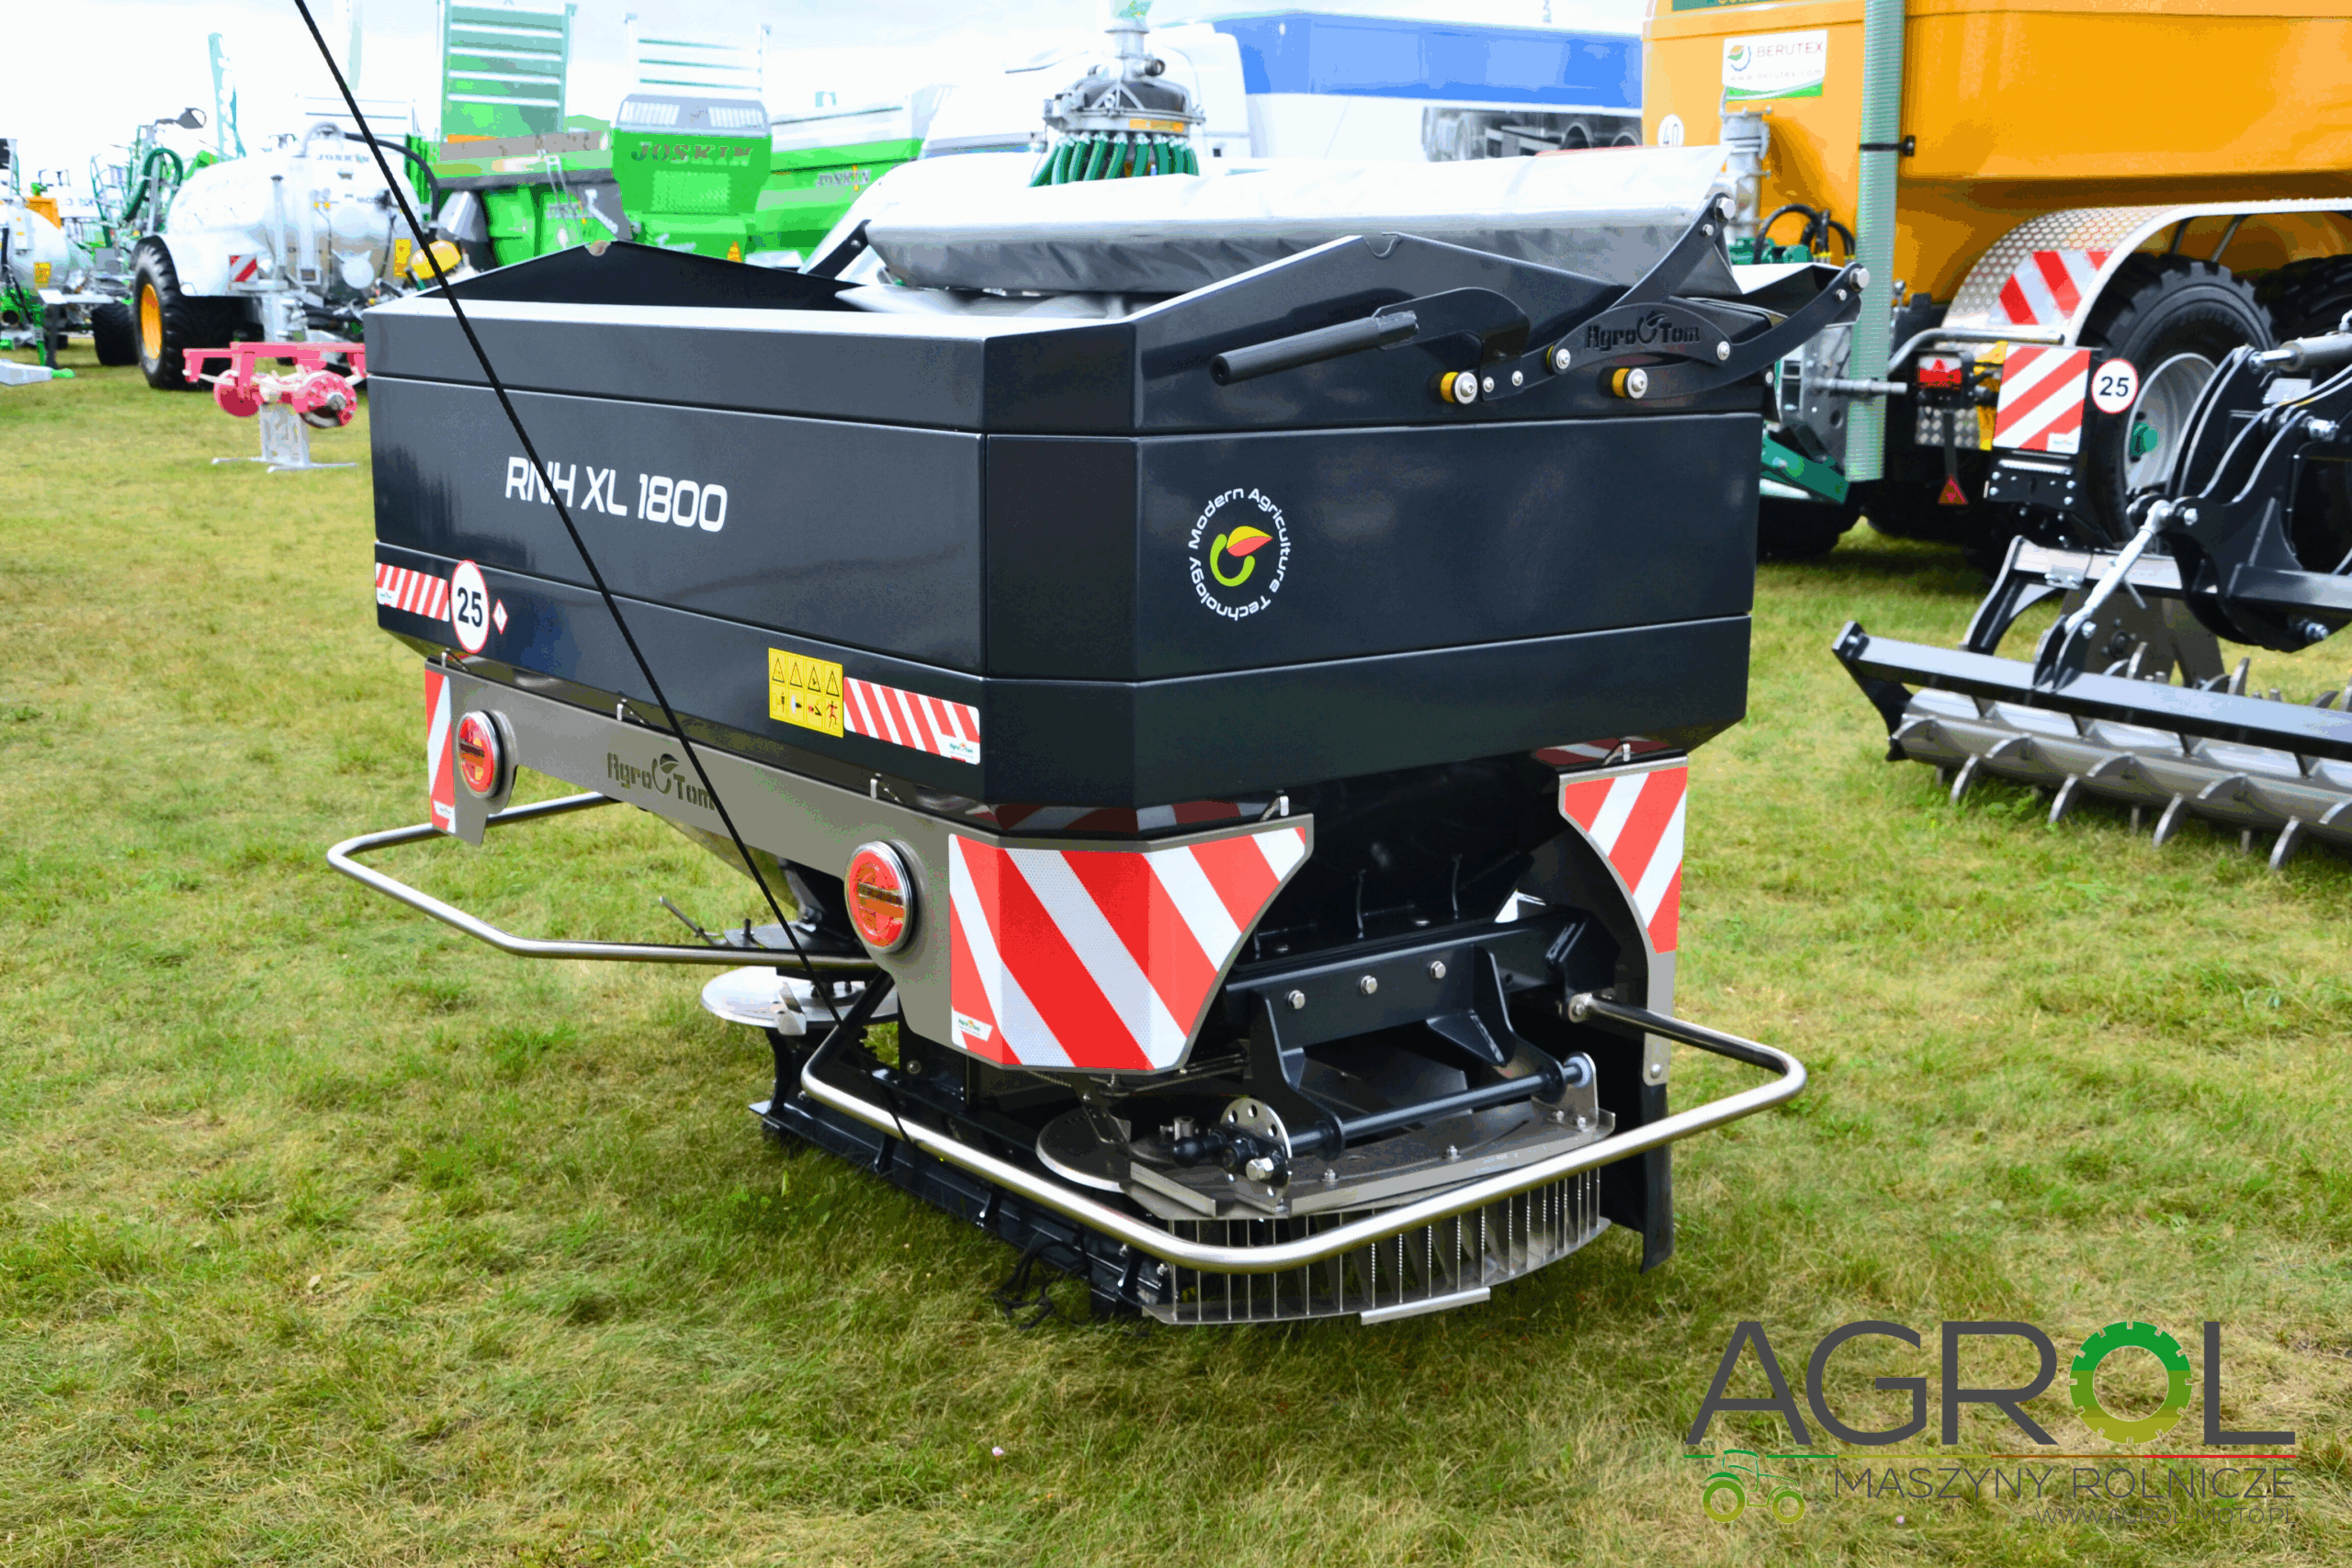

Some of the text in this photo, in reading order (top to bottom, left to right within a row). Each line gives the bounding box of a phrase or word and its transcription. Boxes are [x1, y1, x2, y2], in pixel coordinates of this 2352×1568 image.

[1757, 41, 1824, 58] BERUTEX
[2099, 376, 2129, 397] 25
[505, 457, 728, 532] RNH XL 1800
[1188, 488, 1291, 621] Modern Agriculture Technology
[458, 587, 483, 628] 25
